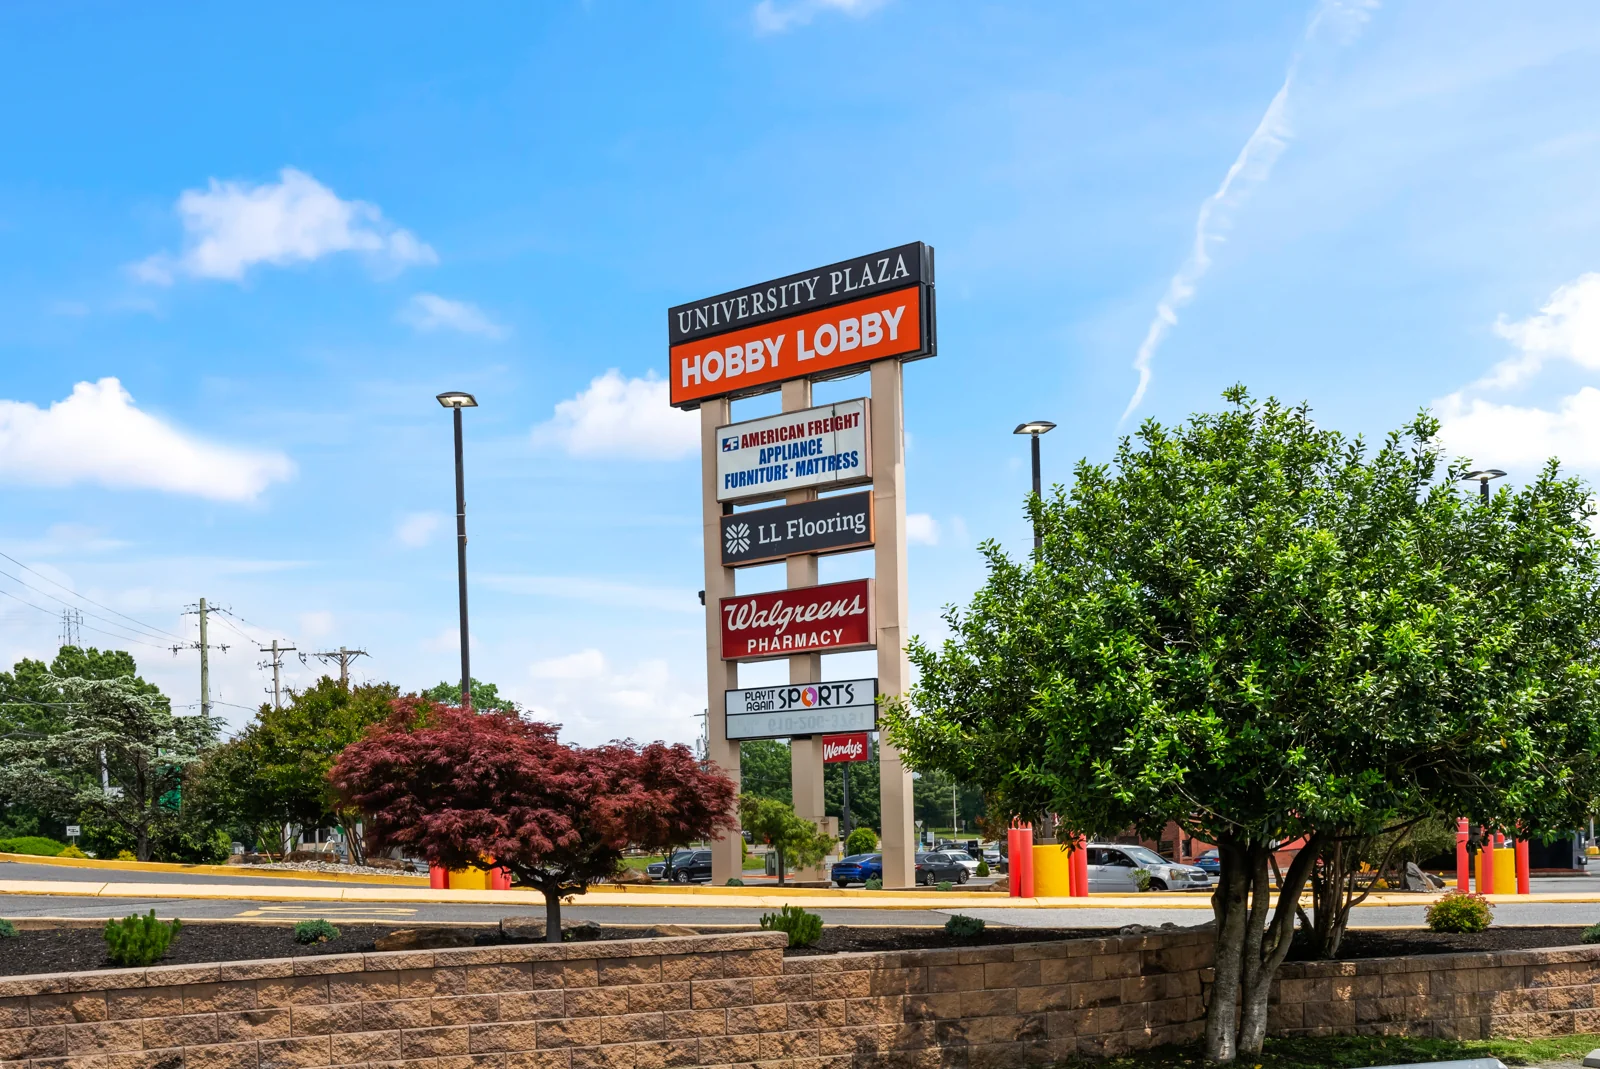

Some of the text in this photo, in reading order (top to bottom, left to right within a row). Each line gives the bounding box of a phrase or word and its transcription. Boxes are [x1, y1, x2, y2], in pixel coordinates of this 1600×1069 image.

[678, 253, 910, 334] UNIVERSITY PLAZA
[681, 305, 906, 388] HOBBY LOBBY
[741, 412, 860, 449] AMERICAN FREIGHT
[759, 438, 823, 465] APPLIANCE
[725, 450, 859, 490] FURNITURE MATTRESS
[758, 512, 866, 545] LL Flooring
[724, 595, 865, 635] Walgreens
[747, 628, 844, 653] PHARMACY
[745, 690, 776, 701] PLAY IT
[746, 700, 775, 712] AGAIN
[778, 683, 854, 709] SPORTS
[823, 738, 863, 761] Wendy's
